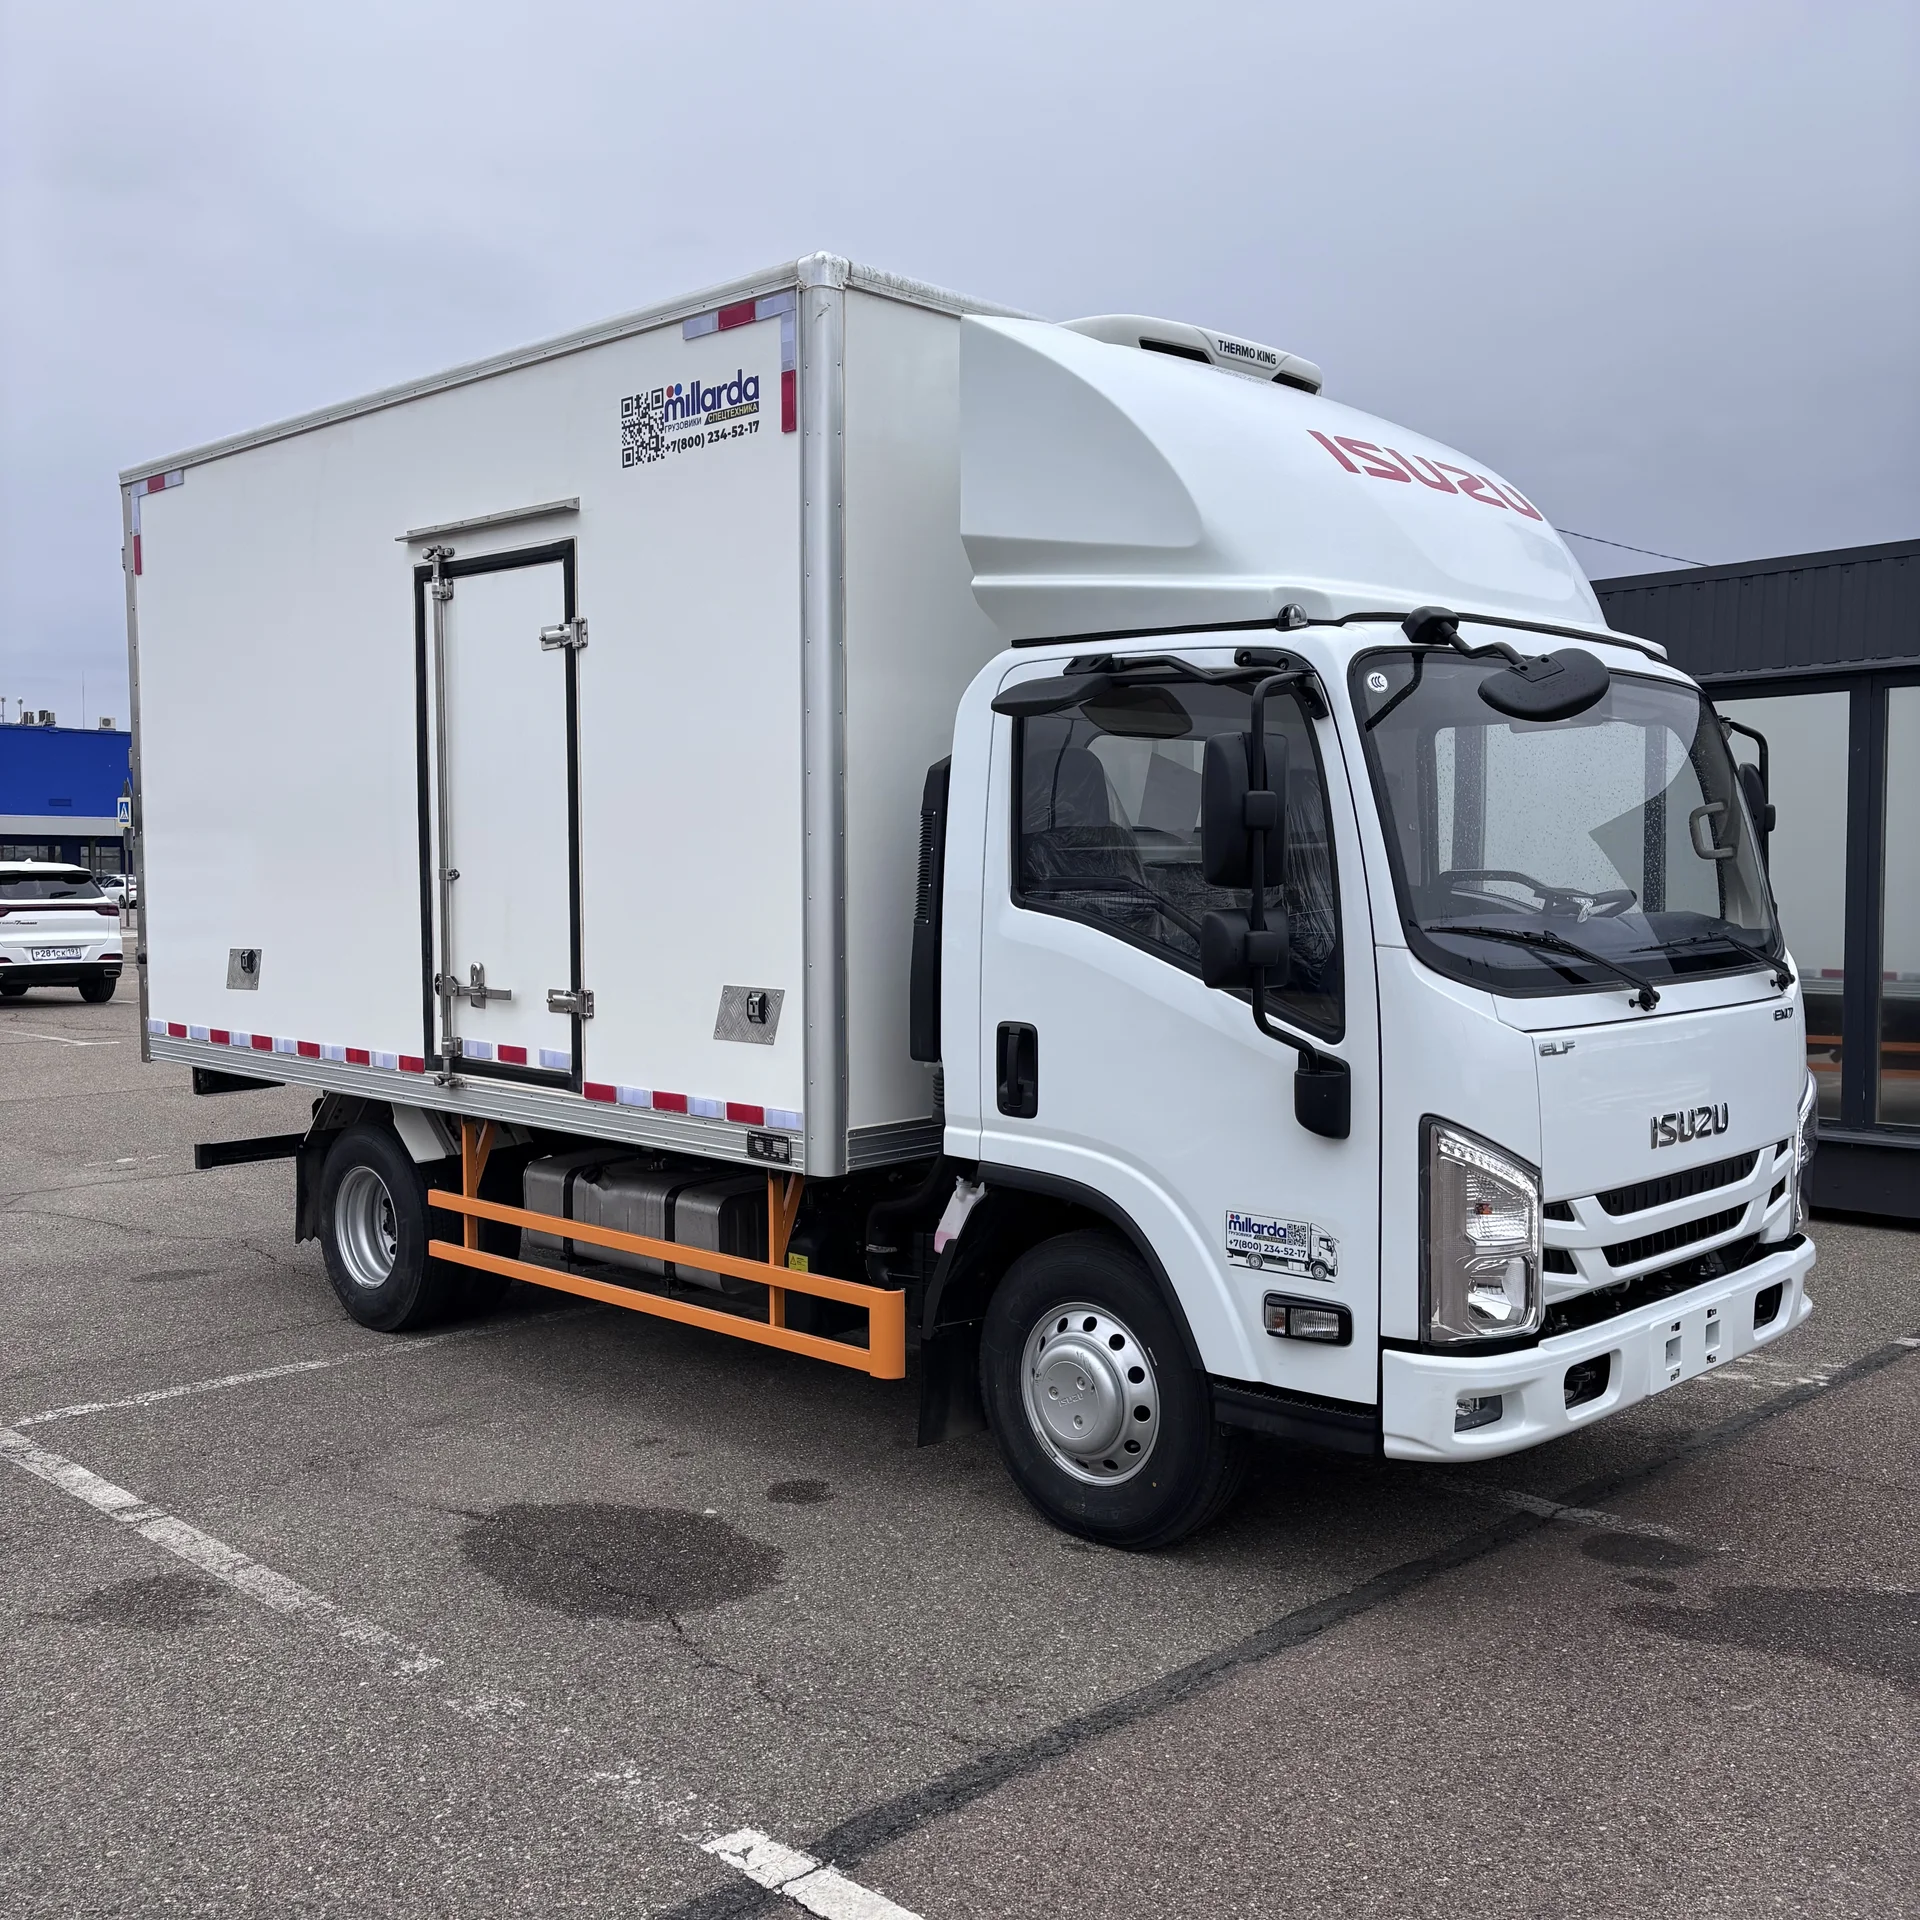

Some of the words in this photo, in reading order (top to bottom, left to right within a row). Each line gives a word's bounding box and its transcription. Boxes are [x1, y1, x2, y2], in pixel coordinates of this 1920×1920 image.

[1218, 340, 1255, 359] THERMO
[1257, 349, 1276, 364] KING
[664, 369, 759, 422] millarda
[664, 417, 701, 434] ГРУЗОВИКИ
[707, 403, 758, 423] СПЕЦТЕХНИКА
[665, 433, 705, 454] +7(800)
[707, 420, 760, 444] 234-52-17
[1306, 429, 1543, 521] ISUZU
[1539, 1040, 1576, 1057] ELF
[1650, 1102, 1729, 1150] ISUZU
[1228, 1216, 1287, 1239] millarda
[1228, 1239, 1262, 1253] +7(800)
[1263, 1244, 1307, 1258] 234-52-17
